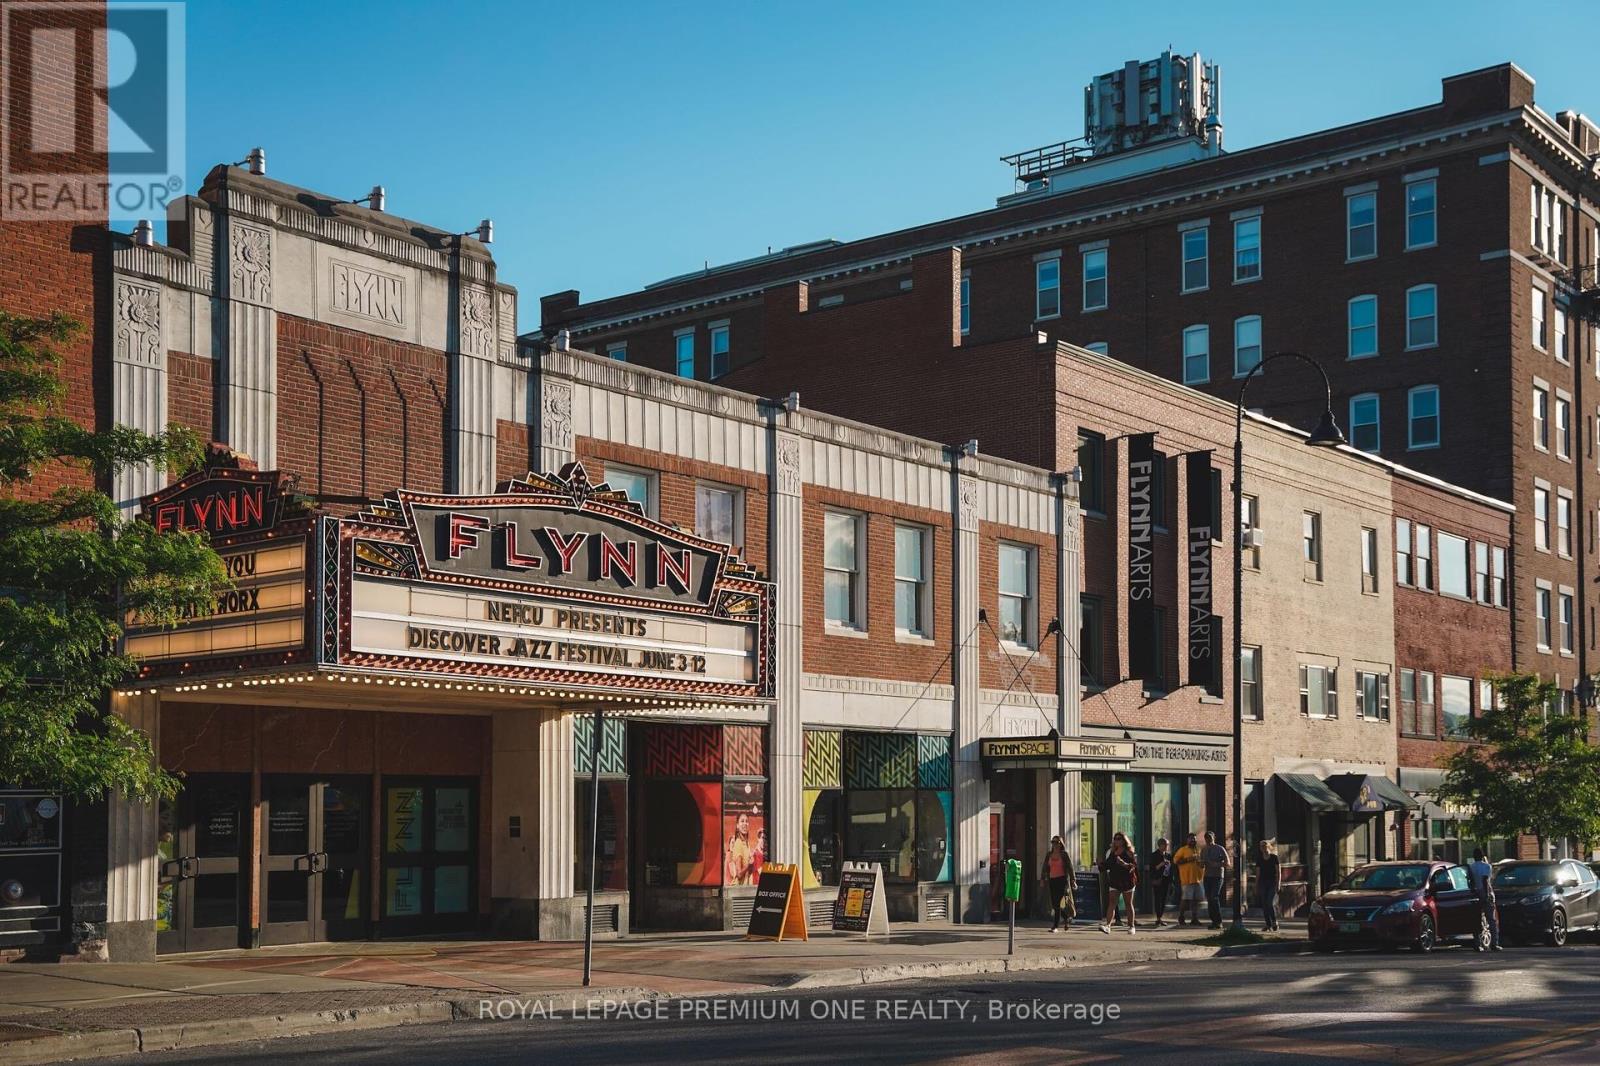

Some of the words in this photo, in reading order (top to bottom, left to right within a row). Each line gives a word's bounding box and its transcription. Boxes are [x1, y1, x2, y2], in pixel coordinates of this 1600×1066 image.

[333, 264, 404, 325] FLYNN
[155, 486, 263, 534] FLYNN
[1130, 459, 1153, 601] FLYNNARTS
[224, 554, 256, 578] YOU
[449, 511, 692, 595] FLYNN
[1189, 525, 1211, 660] FLYNNARTS
[487, 601, 544, 626] NEFCU
[557, 609, 648, 637] PRESENTS
[408, 625, 502, 656] DISCOVER
[506, 637, 553, 660] JAZZ
[557, 642, 633, 668] FESTIVAL
[638, 650, 676, 671] JUNE
[988, 741, 1050, 756] FLYNNSPACE
[1079, 742, 1117, 756] FLYNNSPACE
[1150, 746, 1164, 760] THE
[1165, 747, 1210, 762] PERFORMING
[1211, 749, 1228, 763] ARTS
[757, 889, 769, 898] BOX
[768, 890, 787, 899] OFFICE
